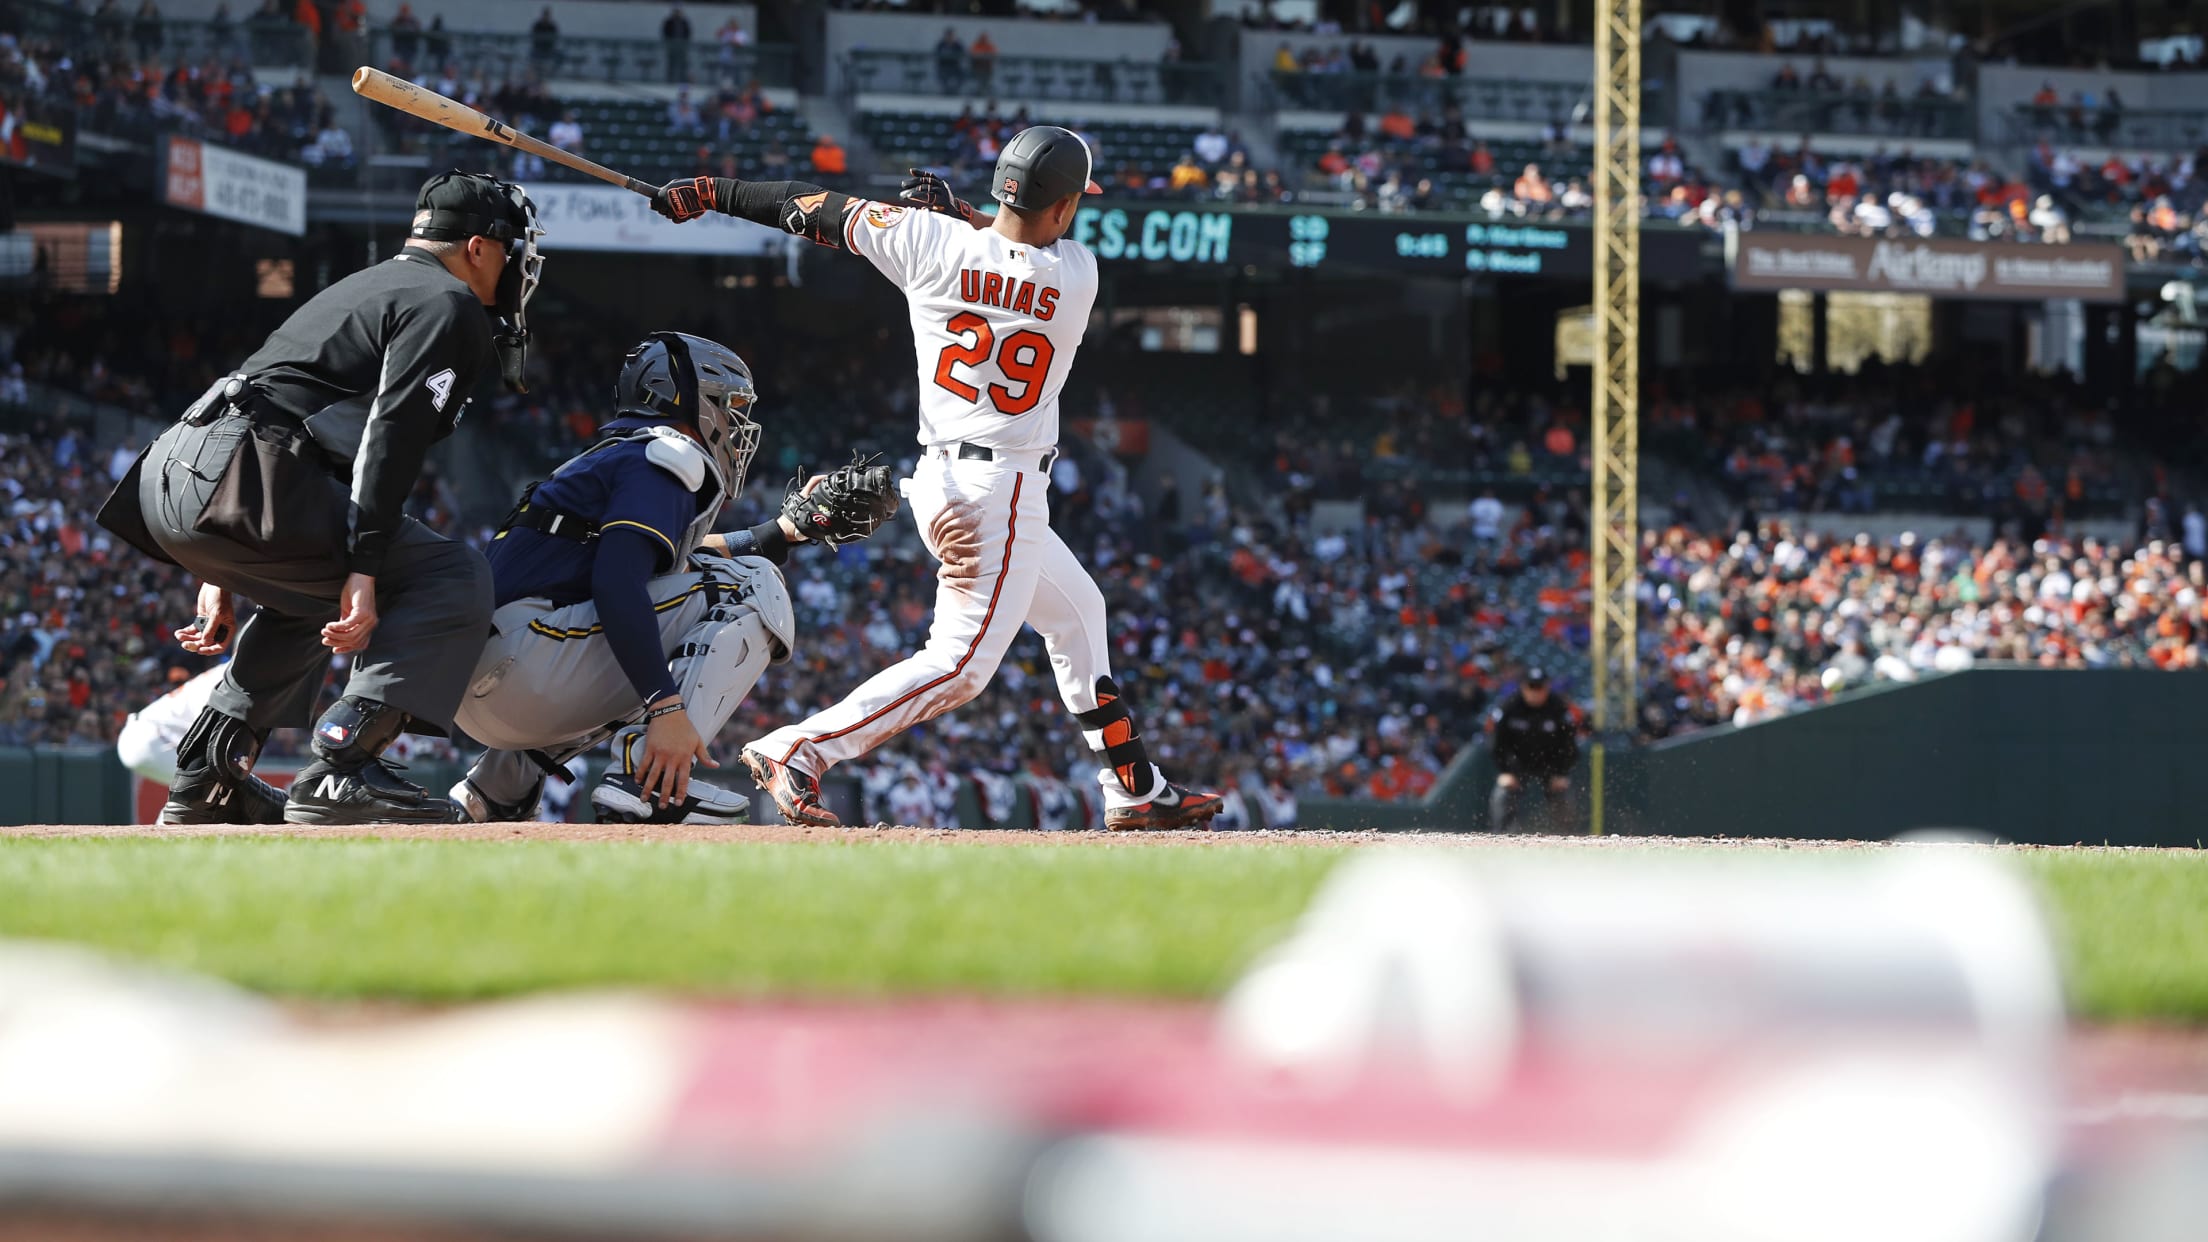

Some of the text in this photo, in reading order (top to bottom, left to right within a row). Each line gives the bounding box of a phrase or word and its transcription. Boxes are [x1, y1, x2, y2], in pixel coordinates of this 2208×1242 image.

[1003, 177, 1019, 193] 29
[961, 269, 1060, 321] URIAS
[934, 310, 1055, 416] 29
[425, 368, 456, 412] 4
[313, 774, 350, 801] N
